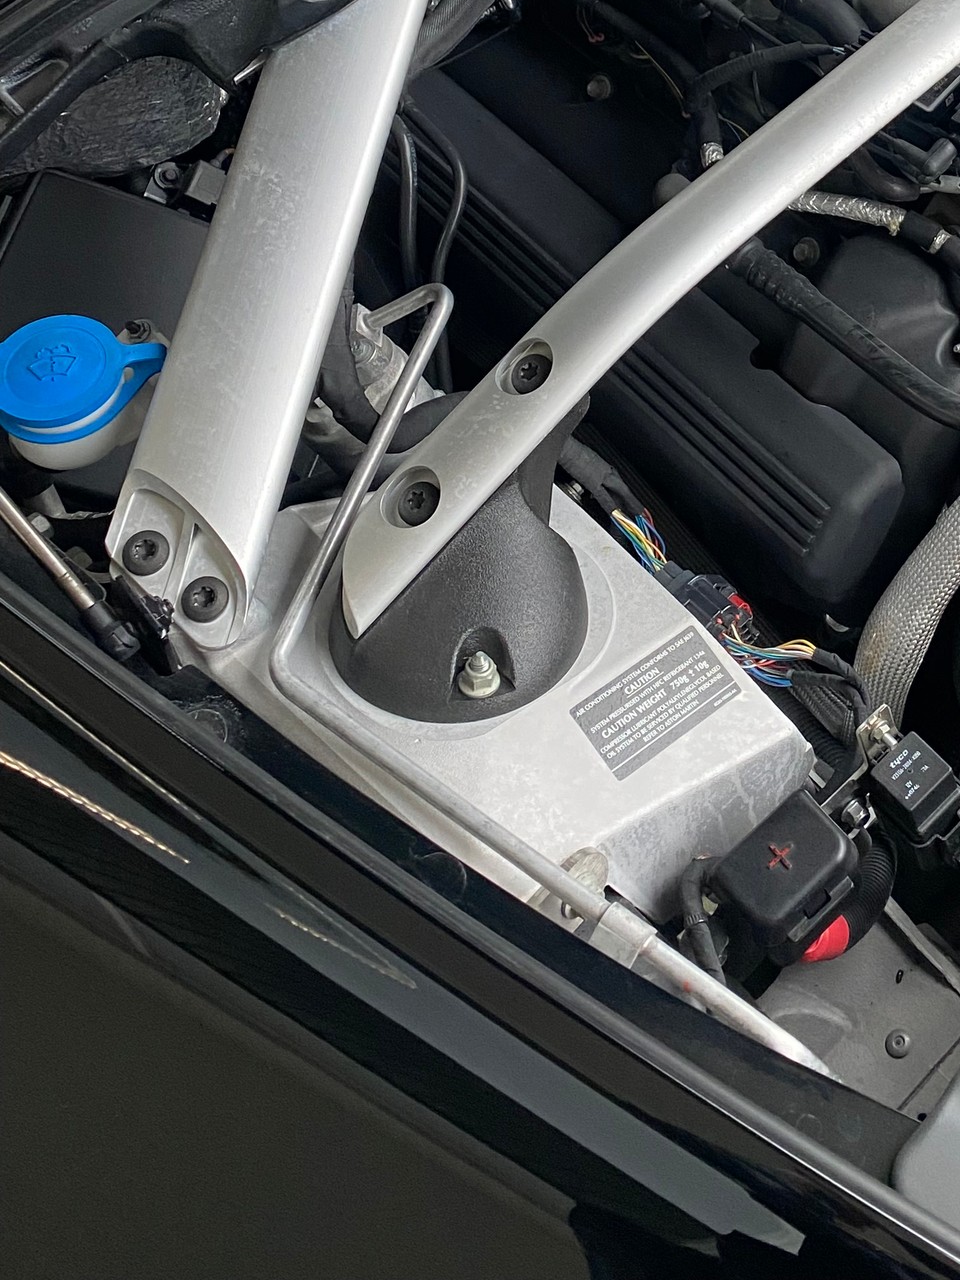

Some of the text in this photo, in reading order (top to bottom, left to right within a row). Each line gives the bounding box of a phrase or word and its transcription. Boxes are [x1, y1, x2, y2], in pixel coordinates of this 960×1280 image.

[583, 680, 623, 711] CONDITIONING
[621, 668, 641, 684] SYSTEM
[639, 649, 668, 672] CONFORMS
[666, 644, 676, 653] TO
[600, 709, 638, 739] CAUTION
[635, 688, 668, 714] WEIGHT
[669, 673, 689, 691] 750g
[693, 659, 709, 674] 10g
[623, 666, 660, 695] CAUTION
[590, 717, 610, 733] SYSTEM
[638, 685, 654, 699] WITH
[599, 728, 632, 754] COMPRESSOR
[630, 709, 658, 732] LUBRICANT
[705, 663, 721, 678] BASED
[605, 749, 616, 759] OIL
[614, 736, 634, 753] SYSTEM
[632, 731, 641, 740] TO
[639, 726, 647, 734] BE
[646, 711, 669, 730] SERVICED
[667, 706, 676, 714] BY
[674, 689, 699, 710] QUALIFIED
[697, 671, 724, 693] PERSONNEL
[655, 723, 665, 733] TO
[663, 712, 681, 727] ASTON
[679, 698, 699, 715] MARTIN
[890, 749, 909, 768] tyco
